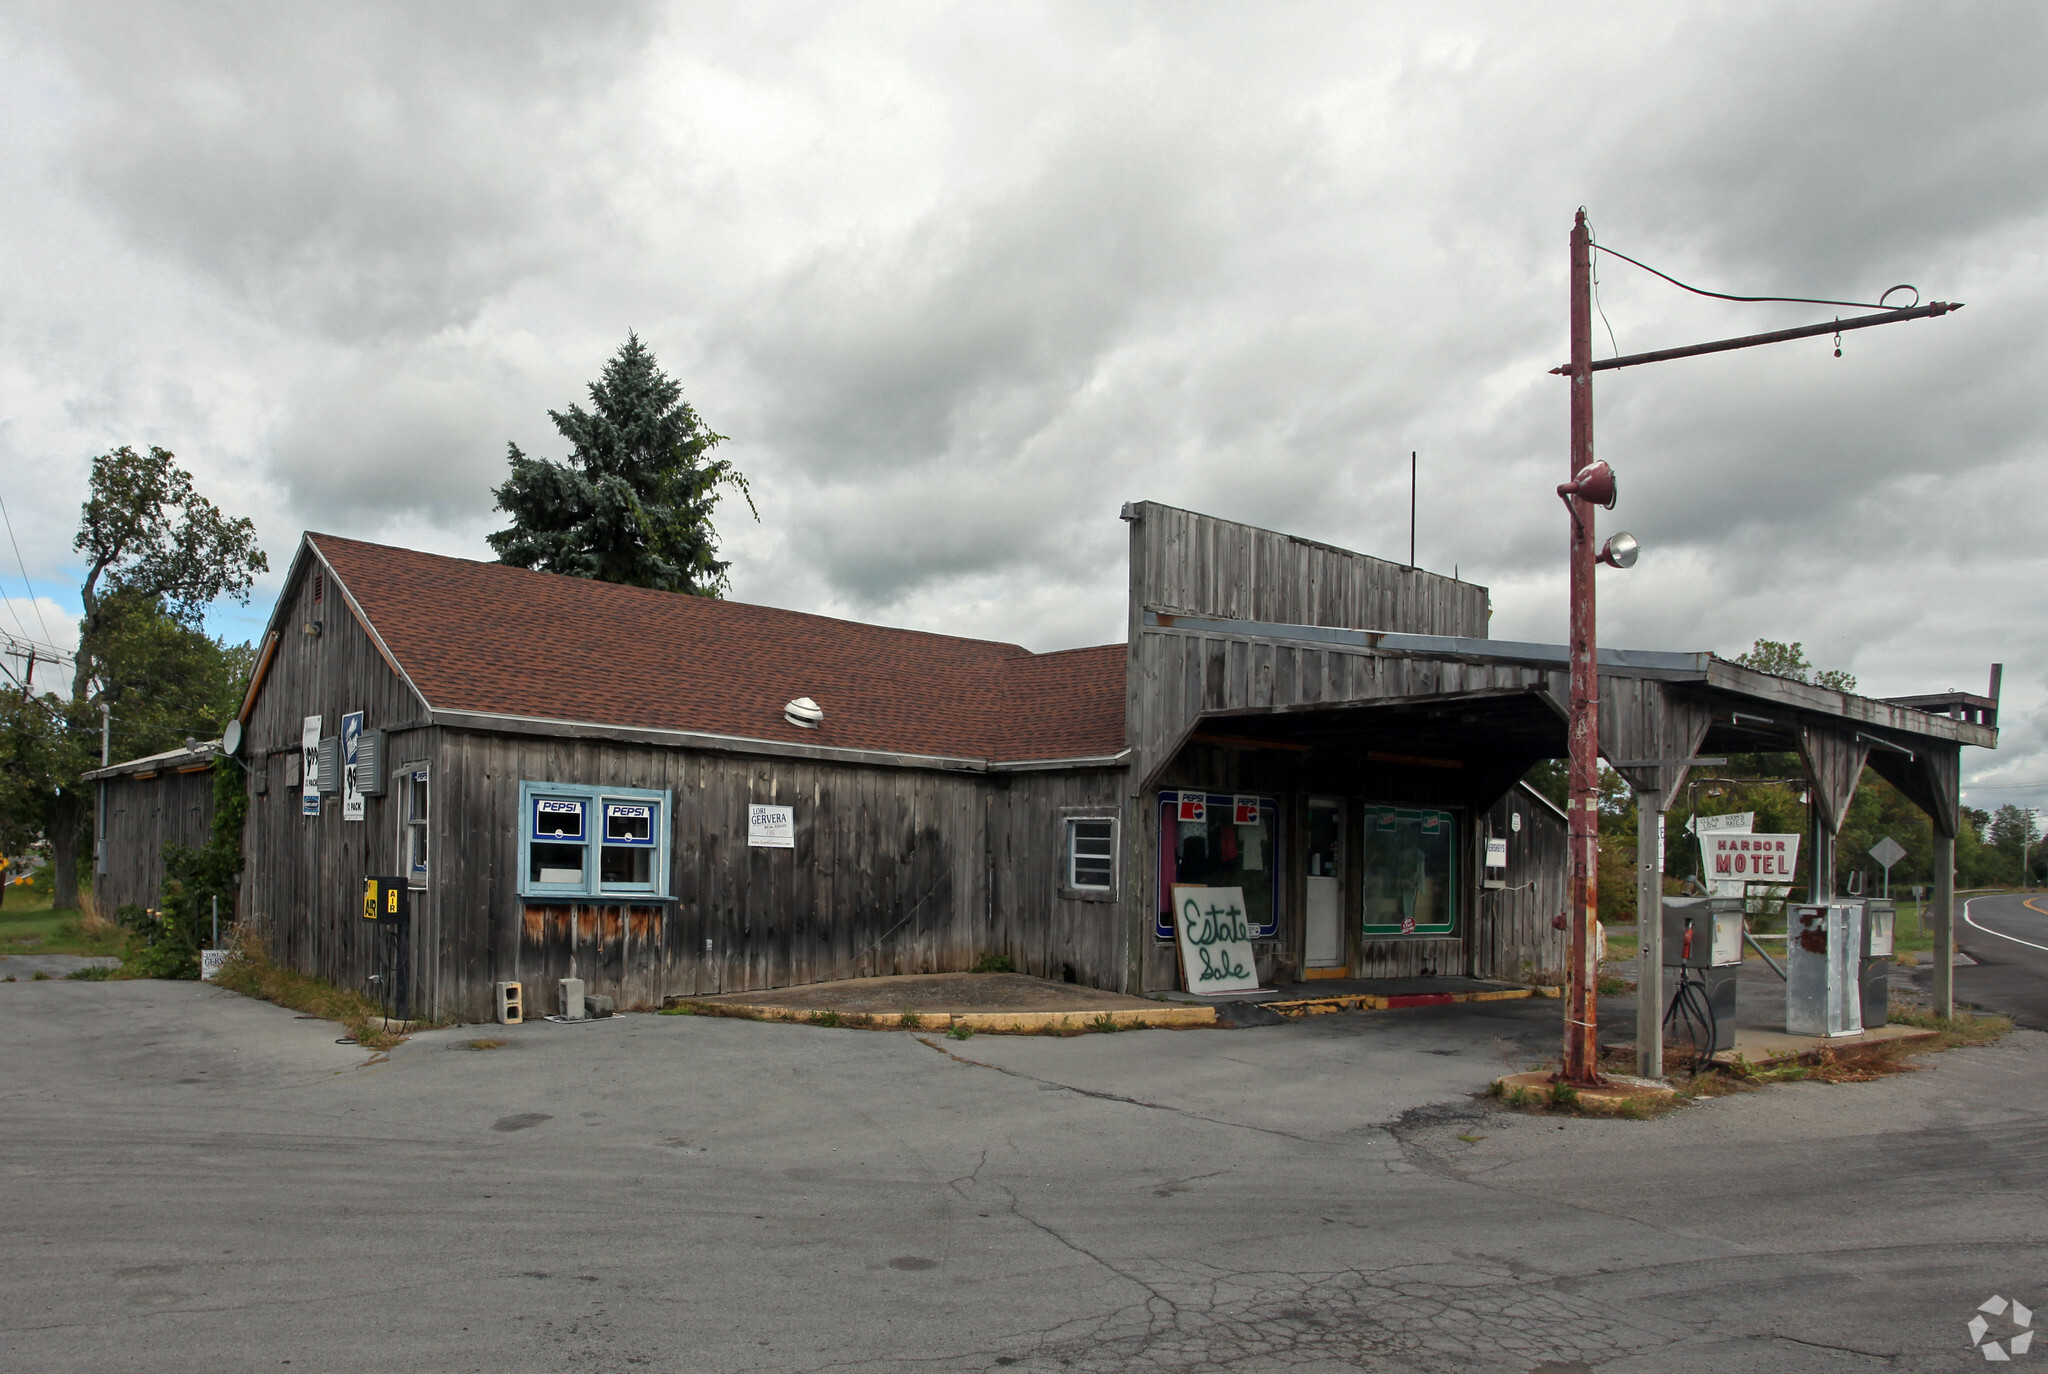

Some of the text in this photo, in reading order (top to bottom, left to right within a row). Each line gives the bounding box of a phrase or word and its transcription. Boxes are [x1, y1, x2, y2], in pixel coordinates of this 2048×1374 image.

[1183, 793, 1204, 802] PEPSI
[1238, 797, 1258, 805] PEPSI
[351, 802, 361, 811] PACK
[542, 802, 577, 812] PEPSI
[612, 806, 645, 816] PEPSI
[753, 807, 766, 815] LORI
[751, 814, 787, 825] GERVERA
[1700, 817, 1719, 825] CLEAN
[1718, 839, 1785, 852] HARBOR
[1716, 853, 1789, 875] MOTEL
[365, 898, 376, 917] AIR
[1184, 898, 1250, 946] Estate
[1199, 947, 1250, 981] Sale
